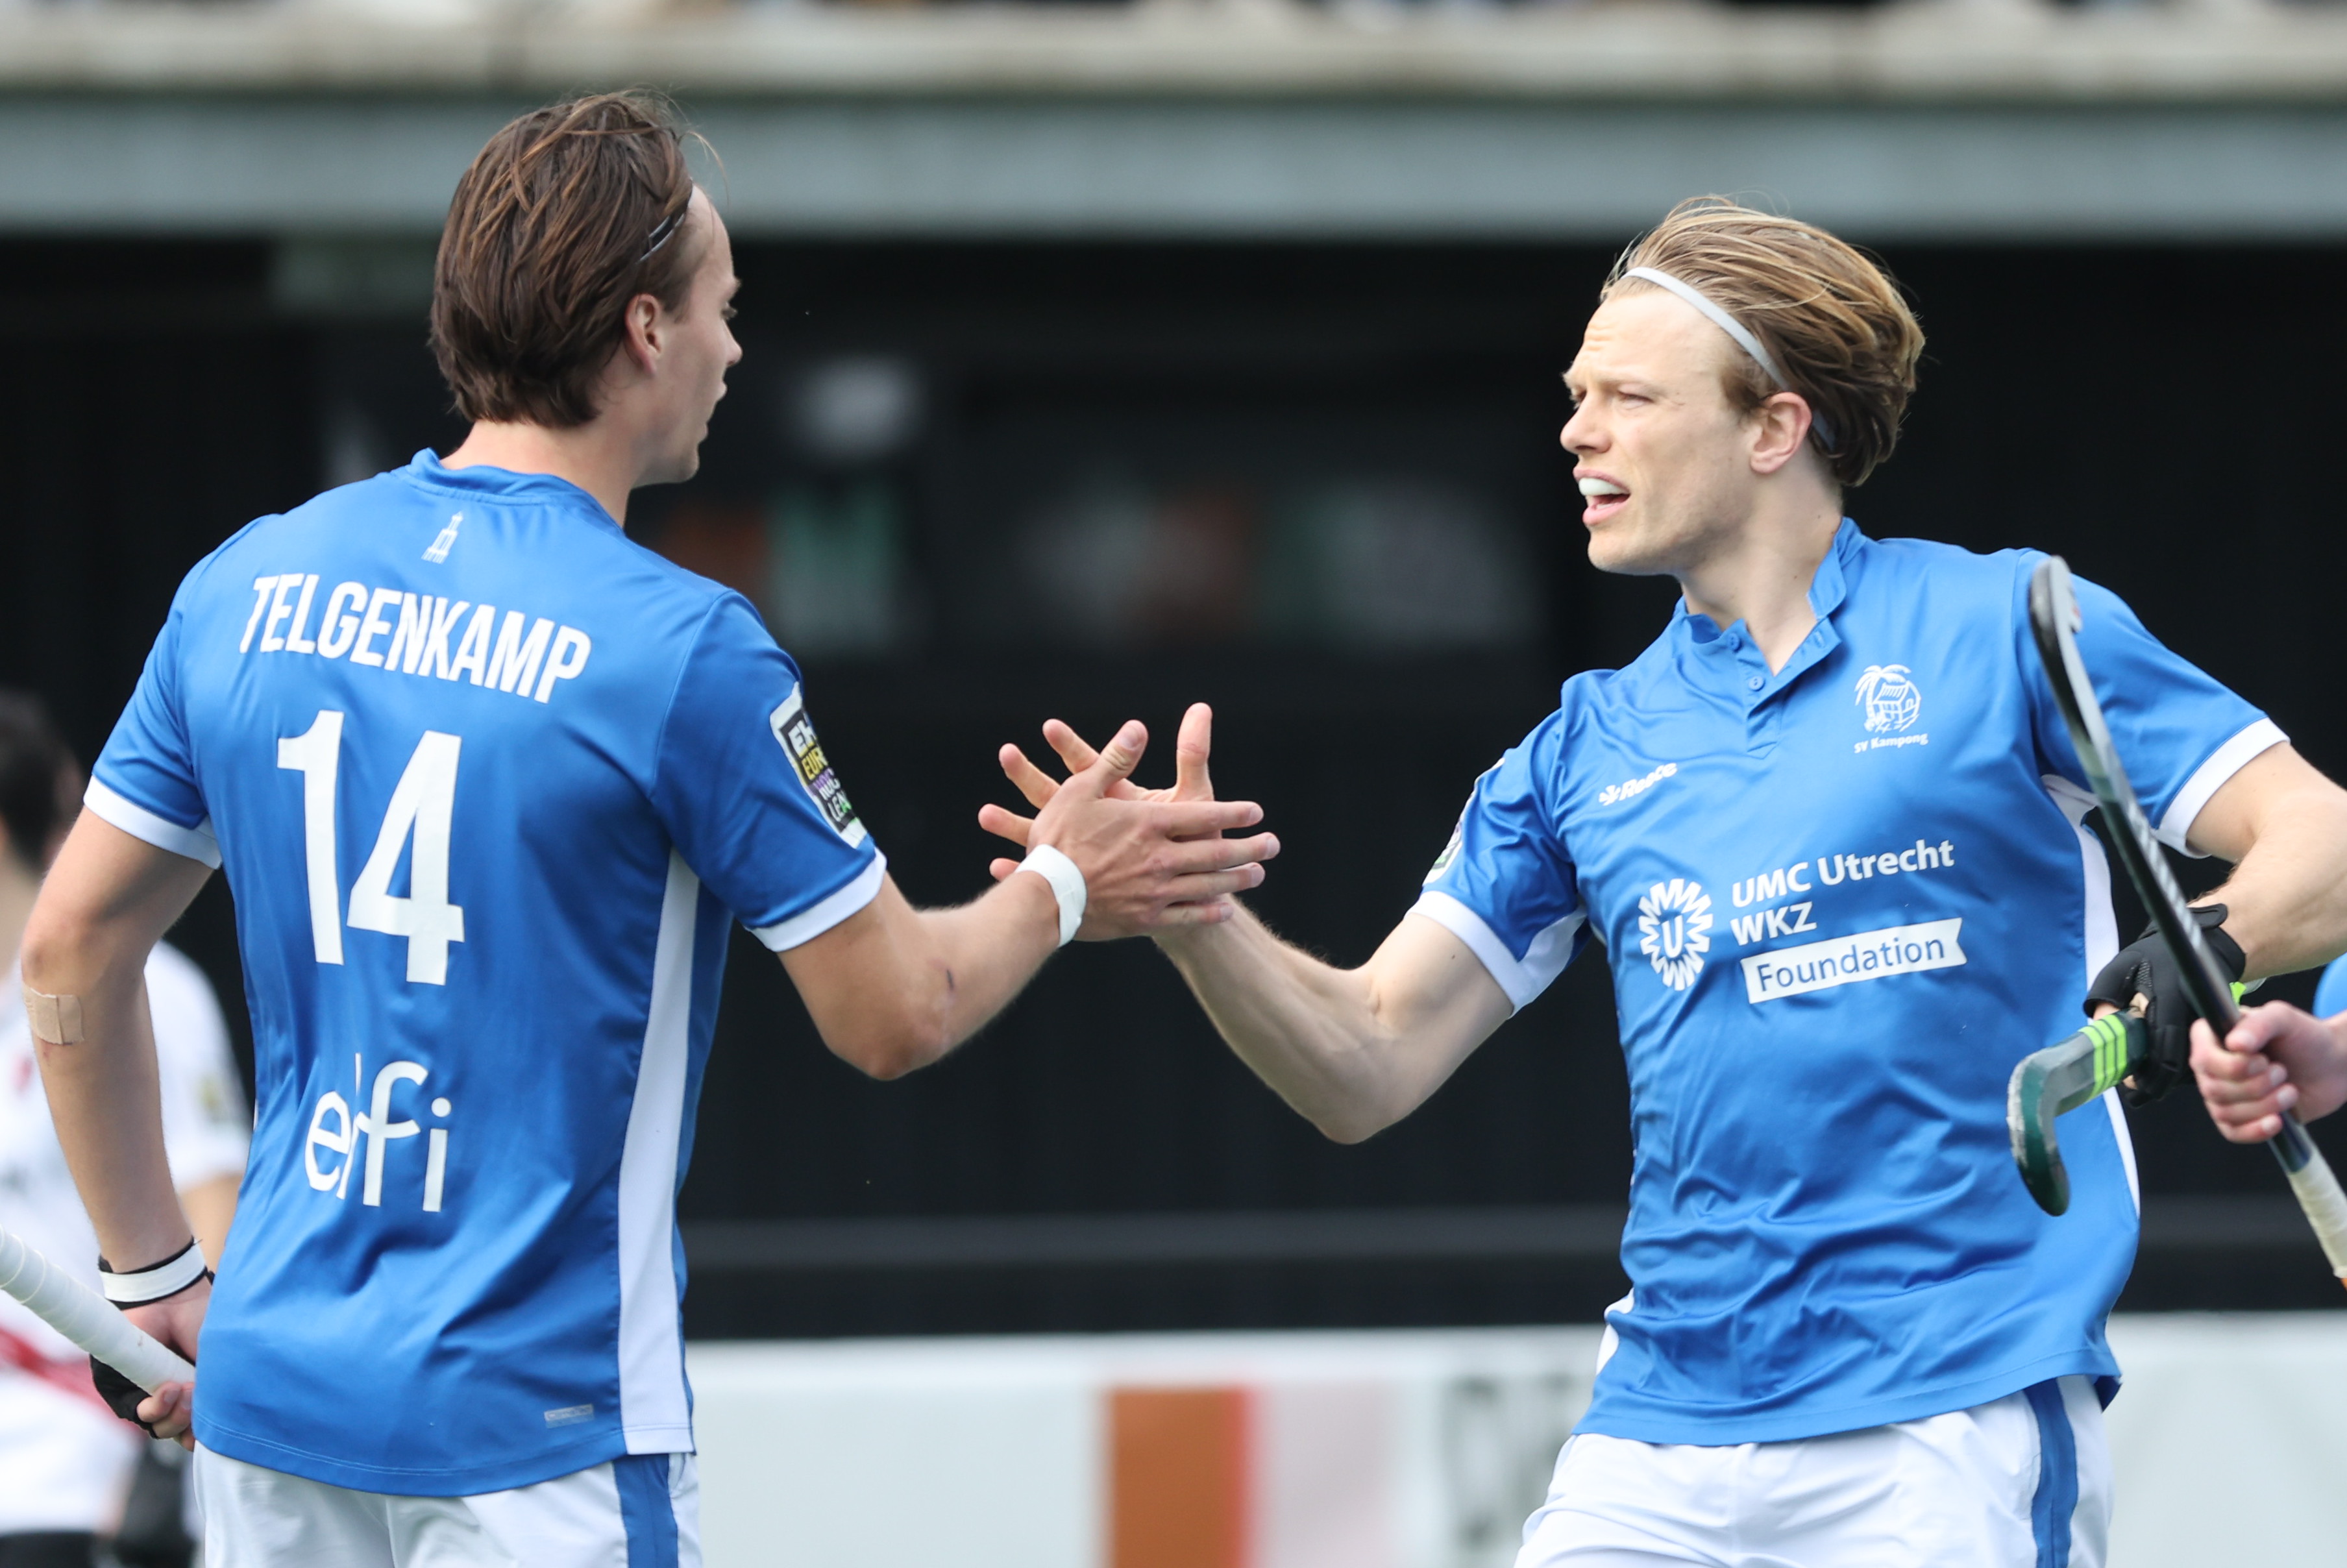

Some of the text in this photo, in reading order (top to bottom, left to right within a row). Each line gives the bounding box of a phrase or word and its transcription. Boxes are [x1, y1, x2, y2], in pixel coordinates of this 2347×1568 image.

[240, 573, 592, 704] TELGENKAMP
[801, 747, 828, 780] EUR
[1854, 733, 1929, 753] SV Kampong
[276, 709, 465, 986] 14
[1732, 839, 1955, 908] UMC Utrecht
[1730, 901, 1817, 946] WKZ
[1756, 937, 1945, 992] Foundation
